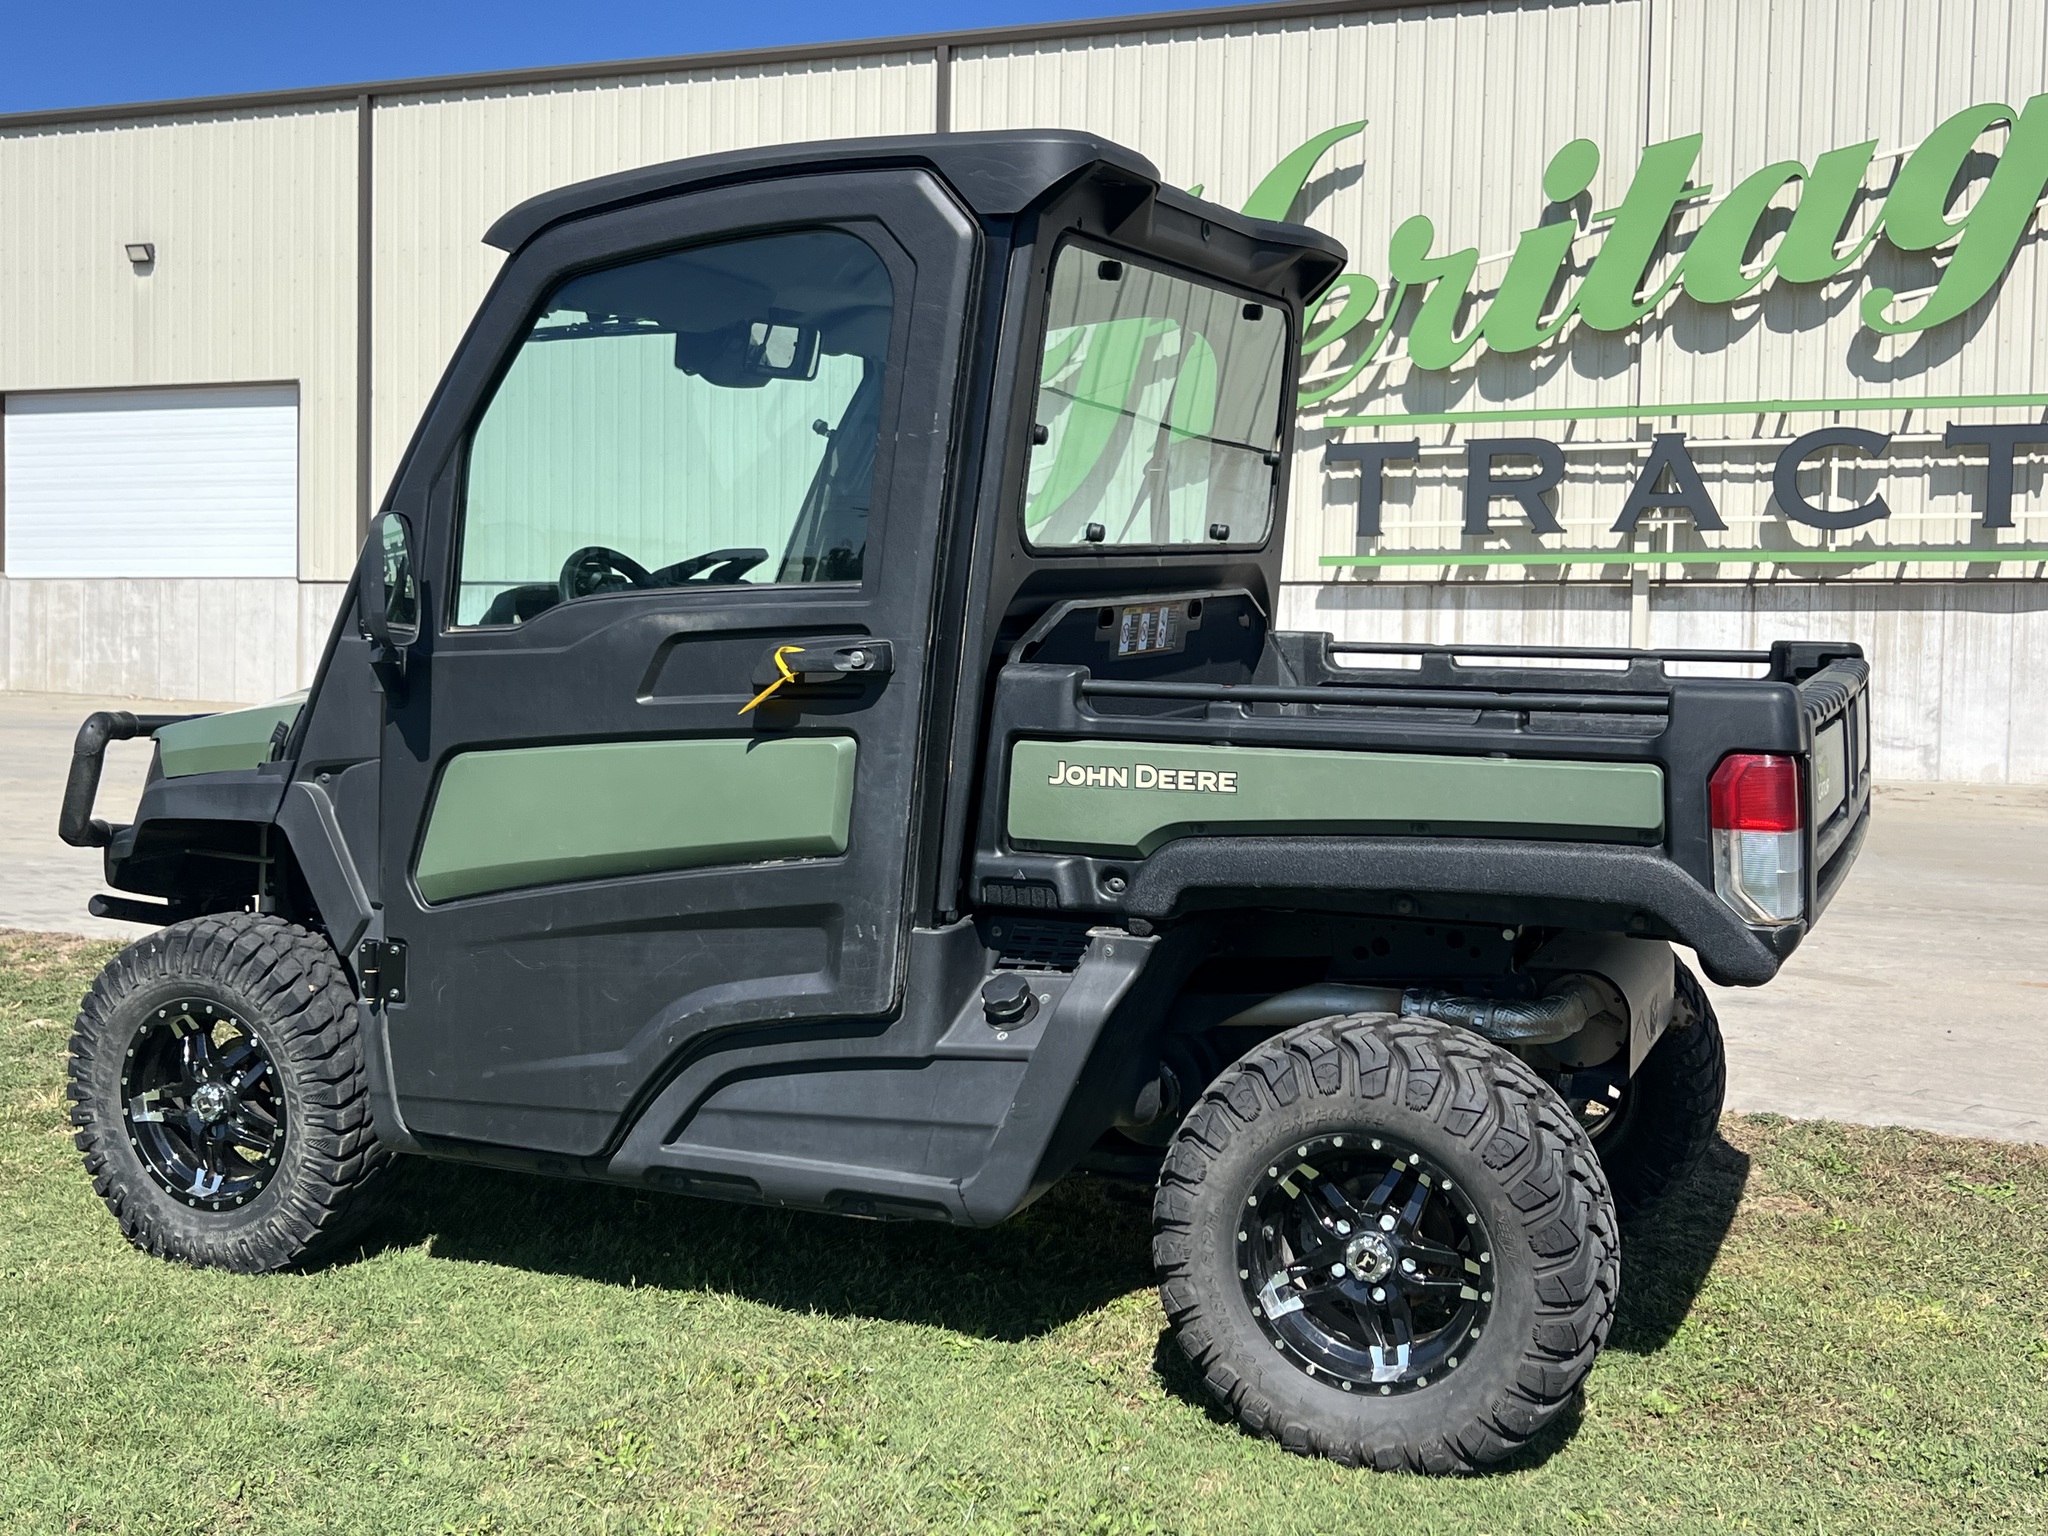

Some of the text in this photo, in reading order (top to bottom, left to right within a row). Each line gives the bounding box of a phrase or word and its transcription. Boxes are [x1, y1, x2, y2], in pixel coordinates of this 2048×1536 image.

[1325, 421, 2048, 538] TRACT
[1048, 760, 1238, 793] JOHN DEERE
